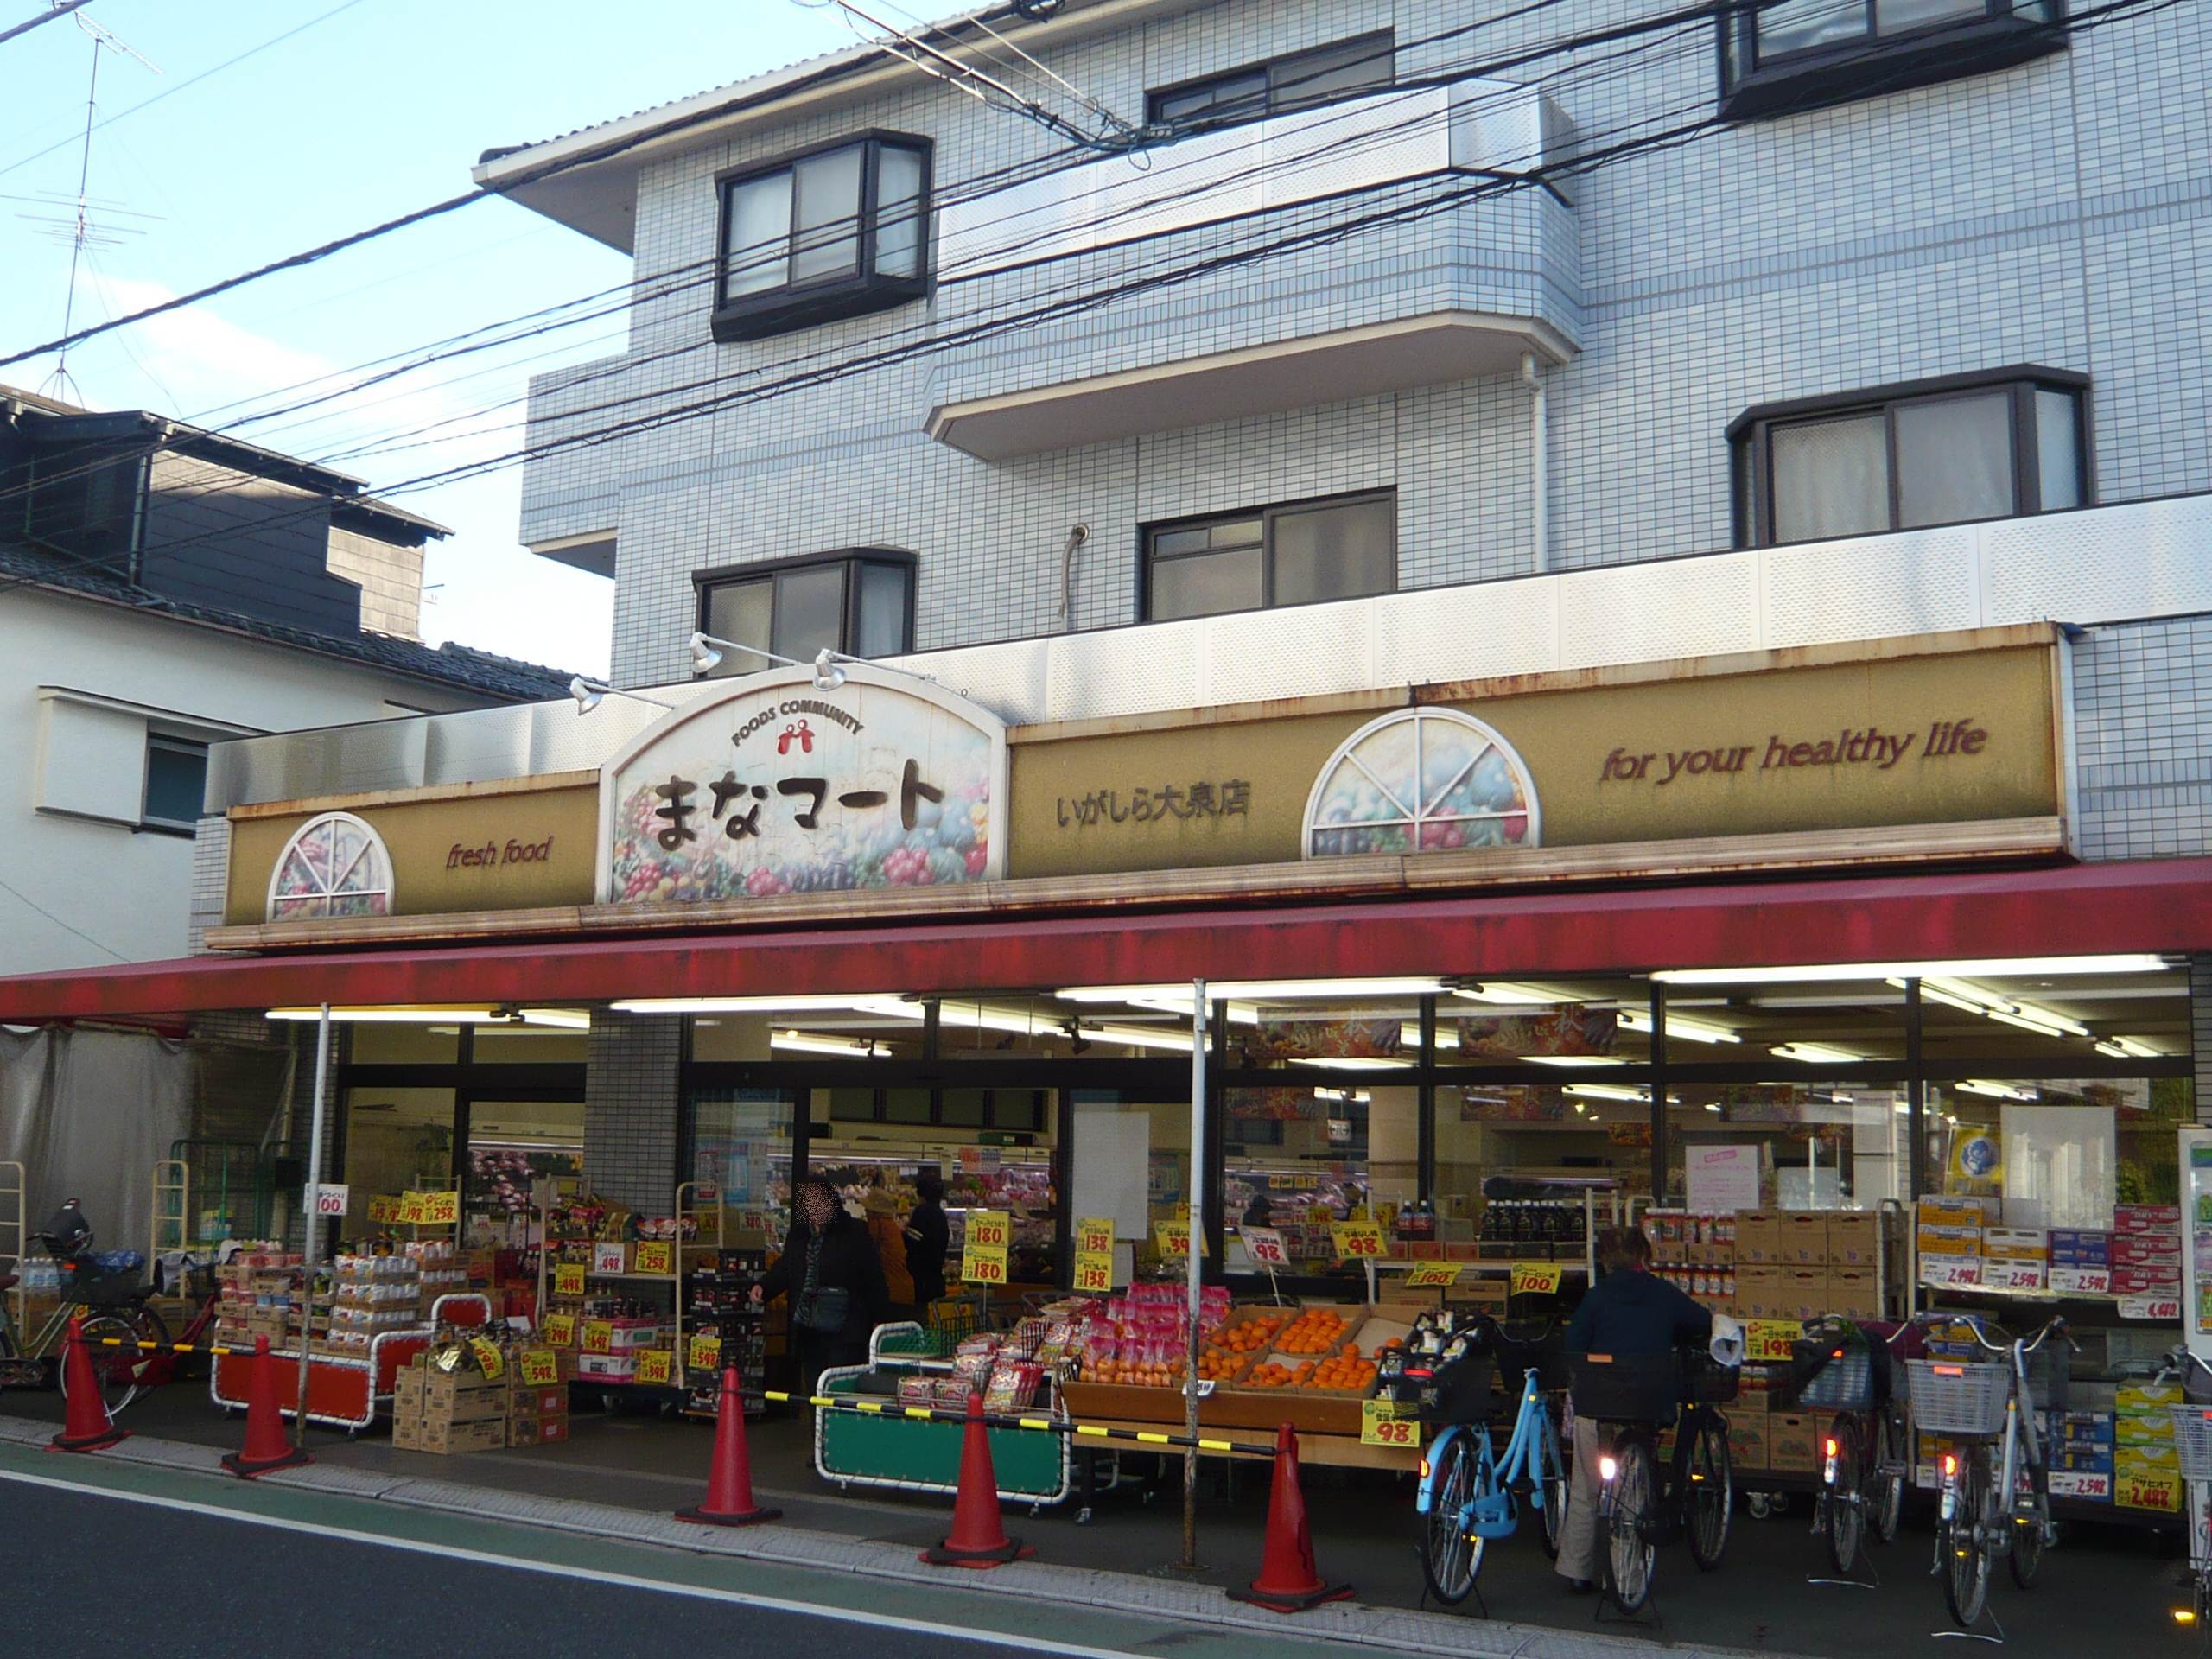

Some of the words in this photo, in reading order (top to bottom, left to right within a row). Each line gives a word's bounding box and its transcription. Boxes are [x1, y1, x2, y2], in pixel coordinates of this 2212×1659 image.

[731, 707, 777, 747] FOODS
[780, 700, 865, 735] COMMUNITY
[1599, 747, 1657, 781] for
[1656, 746, 1756, 786] your
[1760, 728, 1917, 770] healthy
[1923, 719, 1988, 758] life
[655, 757, 944, 851] まなマート
[1057, 779, 1251, 827] いがしら大泉店
[446, 841, 498, 869] fresh
[500, 836, 554, 865] food
[434, 1207, 453, 1221] 258
[976, 1227, 1002, 1244] 180
[1085, 1234, 1108, 1251] 138
[1255, 1243, 1281, 1261] 98
[1348, 1238, 1378, 1255] 98
[974, 1262, 1001, 1280] 180
[1084, 1269, 1107, 1287] 138
[1419, 1273, 1449, 1284] 100
[1519, 1276, 1550, 1291] 100
[1764, 1339, 1793, 1356] 198
[697, 1351, 718, 1367] 598
[531, 1365, 552, 1380] 598
[1376, 1422, 1411, 1443] 98
